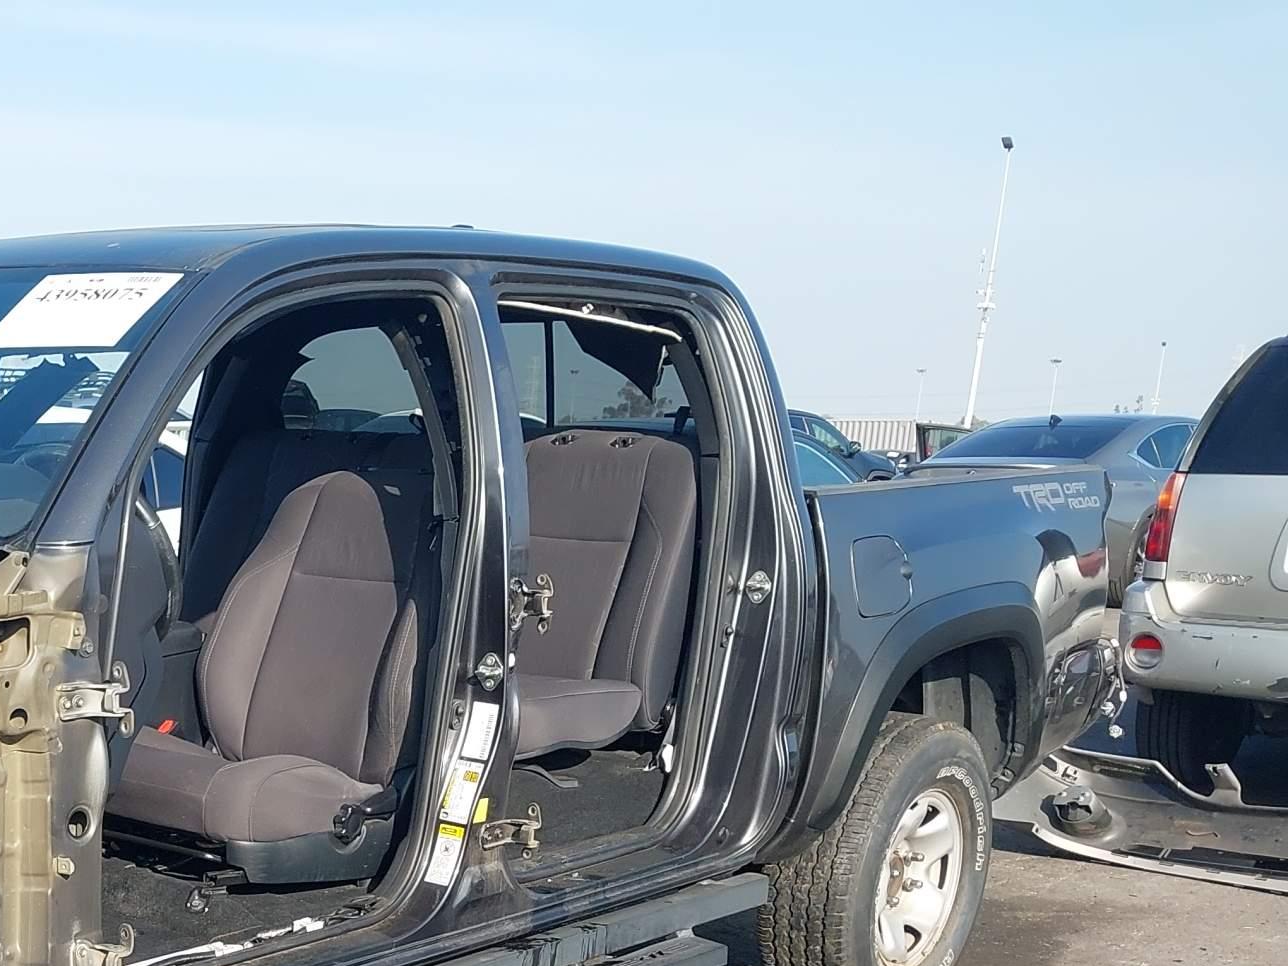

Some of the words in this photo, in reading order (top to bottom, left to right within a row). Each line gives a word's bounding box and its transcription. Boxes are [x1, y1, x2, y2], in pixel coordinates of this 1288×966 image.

[35, 287, 149, 303] 43958075
[1063, 481, 1087, 494] OFF
[1012, 481, 1065, 513] TRD
[1067, 496, 1101, 510] ROAD
[1175, 570, 1254, 587] ENVOY
[936, 765, 987, 871] BFGoodrich
